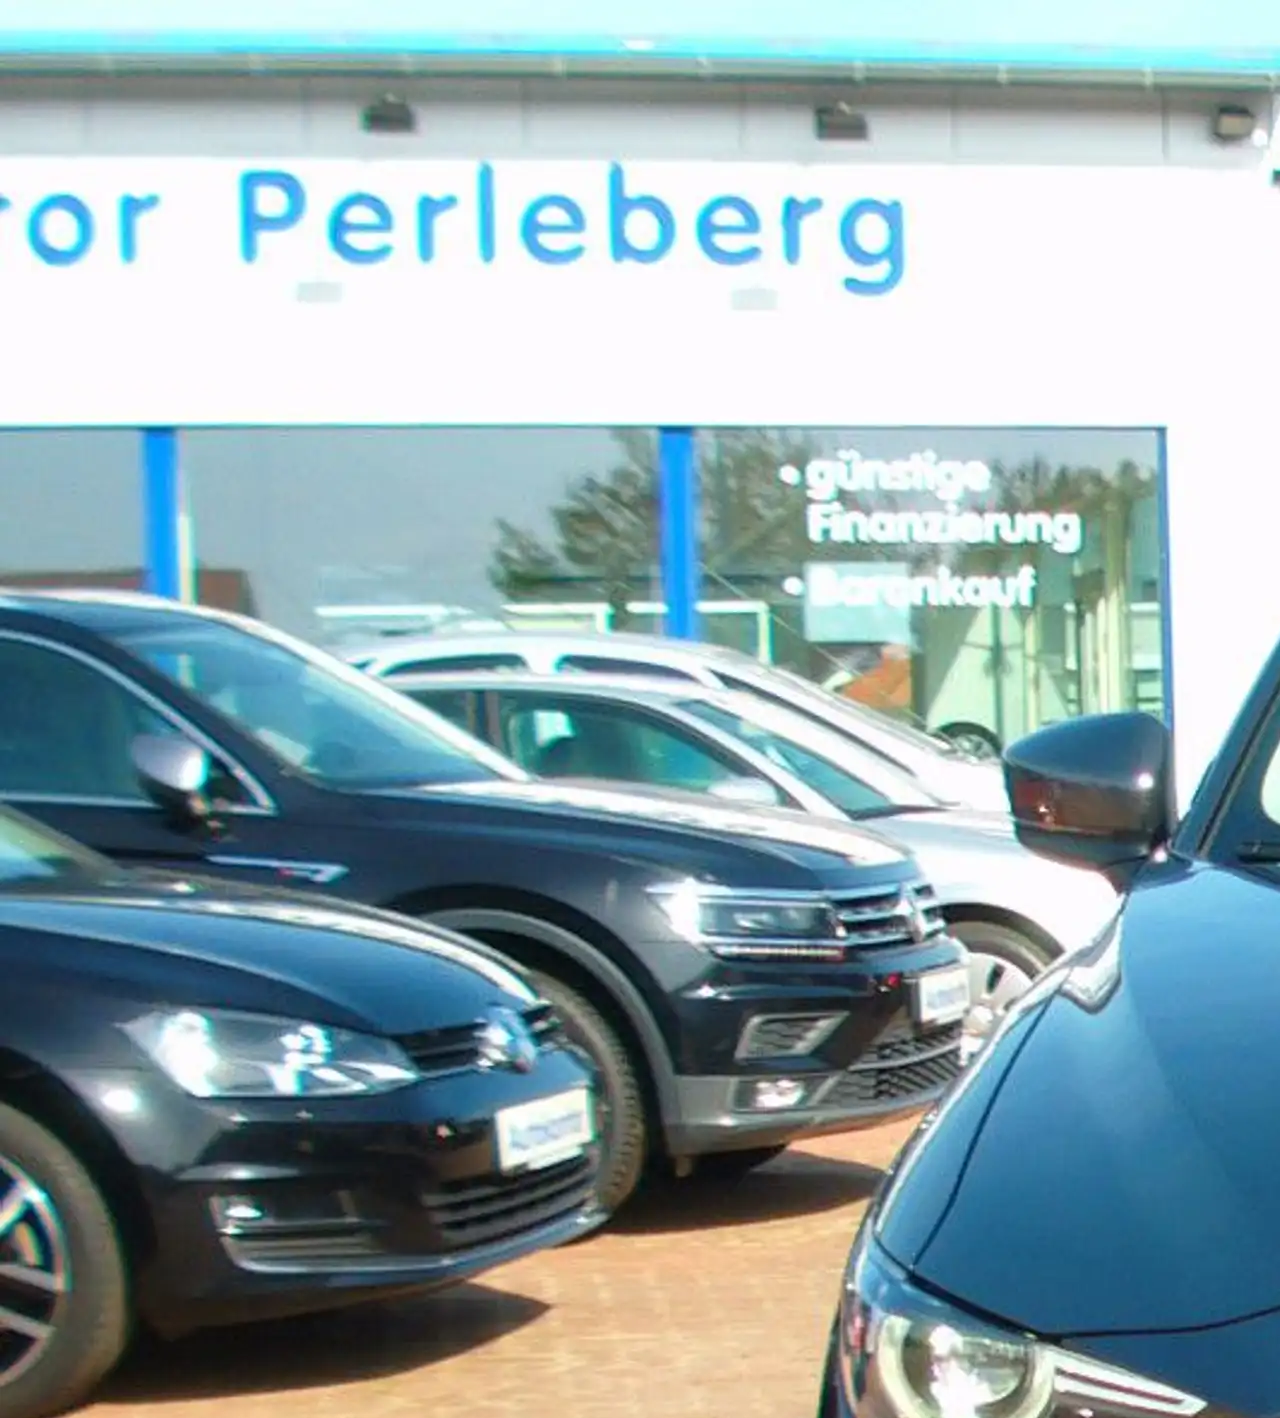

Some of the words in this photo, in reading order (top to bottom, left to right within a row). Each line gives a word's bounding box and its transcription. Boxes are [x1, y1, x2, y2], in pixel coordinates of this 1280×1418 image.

[0, 191, 160, 268] or
[237, 161, 906, 296] Perleberg
[806, 449, 991, 501] günstige
[807, 501, 1082, 554] Finanzierung
